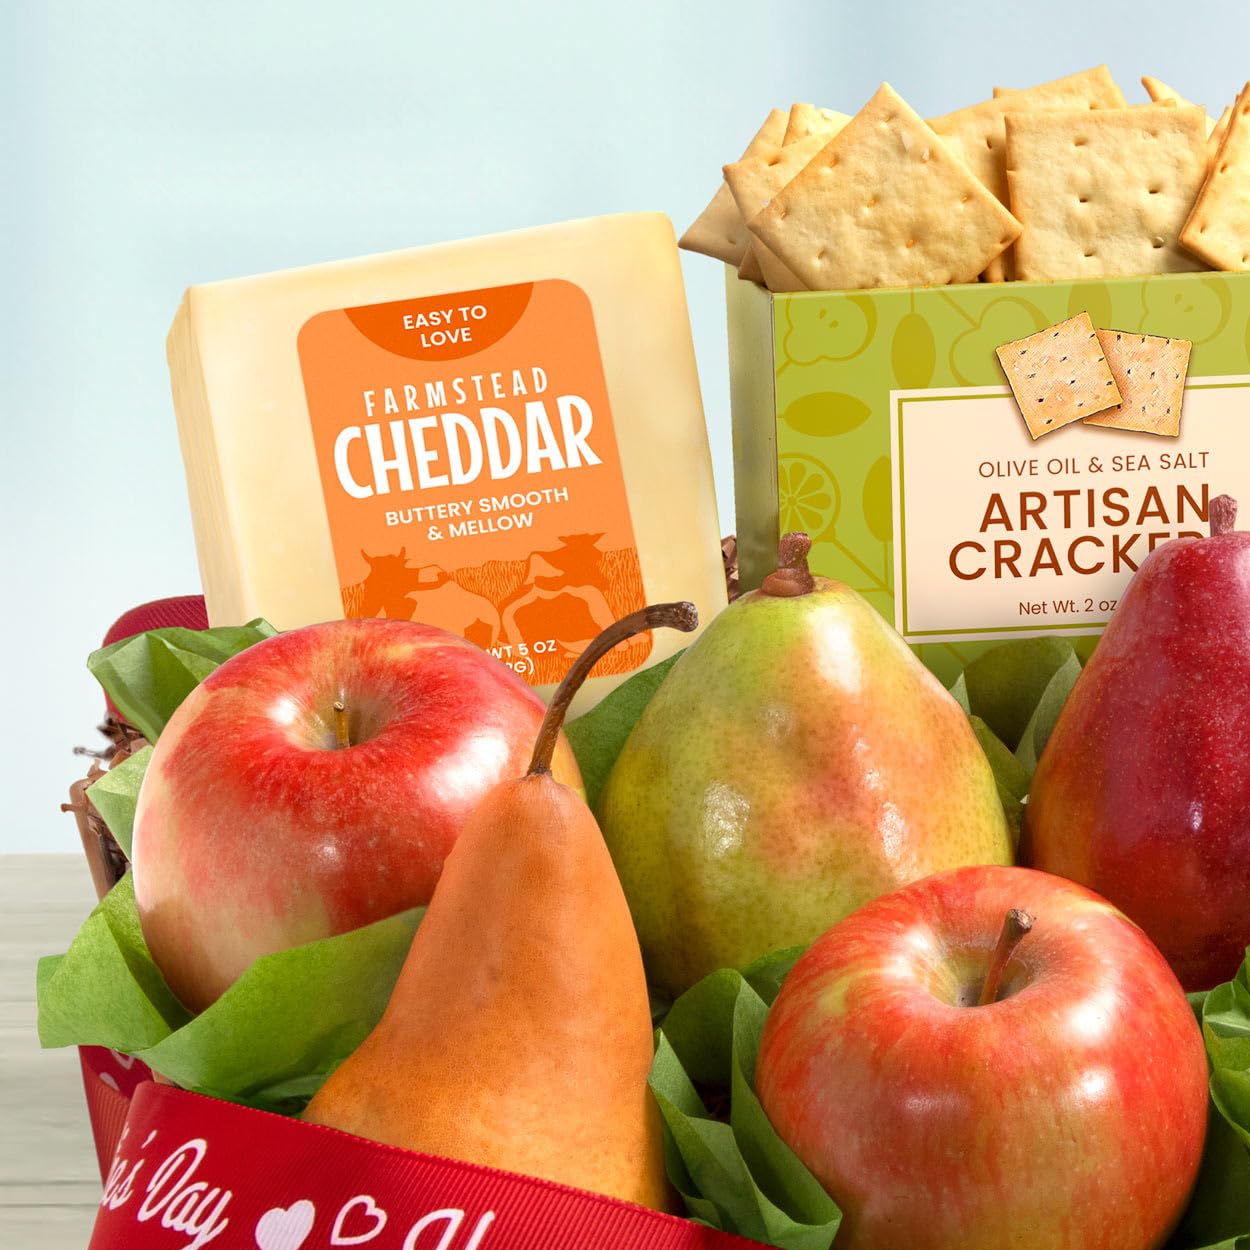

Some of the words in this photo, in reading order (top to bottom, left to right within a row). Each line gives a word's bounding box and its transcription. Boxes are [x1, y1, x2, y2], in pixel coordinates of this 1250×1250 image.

[403, 309, 453, 330] EASY
[459, 305, 487, 323] TO
[420, 327, 472, 348] LOVE
[364, 367, 548, 417] FARMSTEAD
[334, 395, 603, 498] CHEDDAR
[979, 459, 1038, 478] OLIVE
[1047, 457, 1081, 475] OIL
[1088, 456, 1104, 474] &
[1112, 454, 1151, 473] SEA
[1159, 452, 1210, 471] SALT
[385, 500, 473, 526] BUTTERY
[478, 487, 569, 513] SMOOTH
[979, 483, 1209, 532] ARTISAN
[427, 525, 444, 541] &
[449, 512, 534, 537] MELLOW
[1019, 601, 1048, 615] Net
[1053, 599, 1080, 613] Wt.
[1084, 599, 1094, 612] 2
[1099, 601, 1117, 612] oz
[518, 643, 529, 656] 5
[533, 640, 557, 653] OZ
